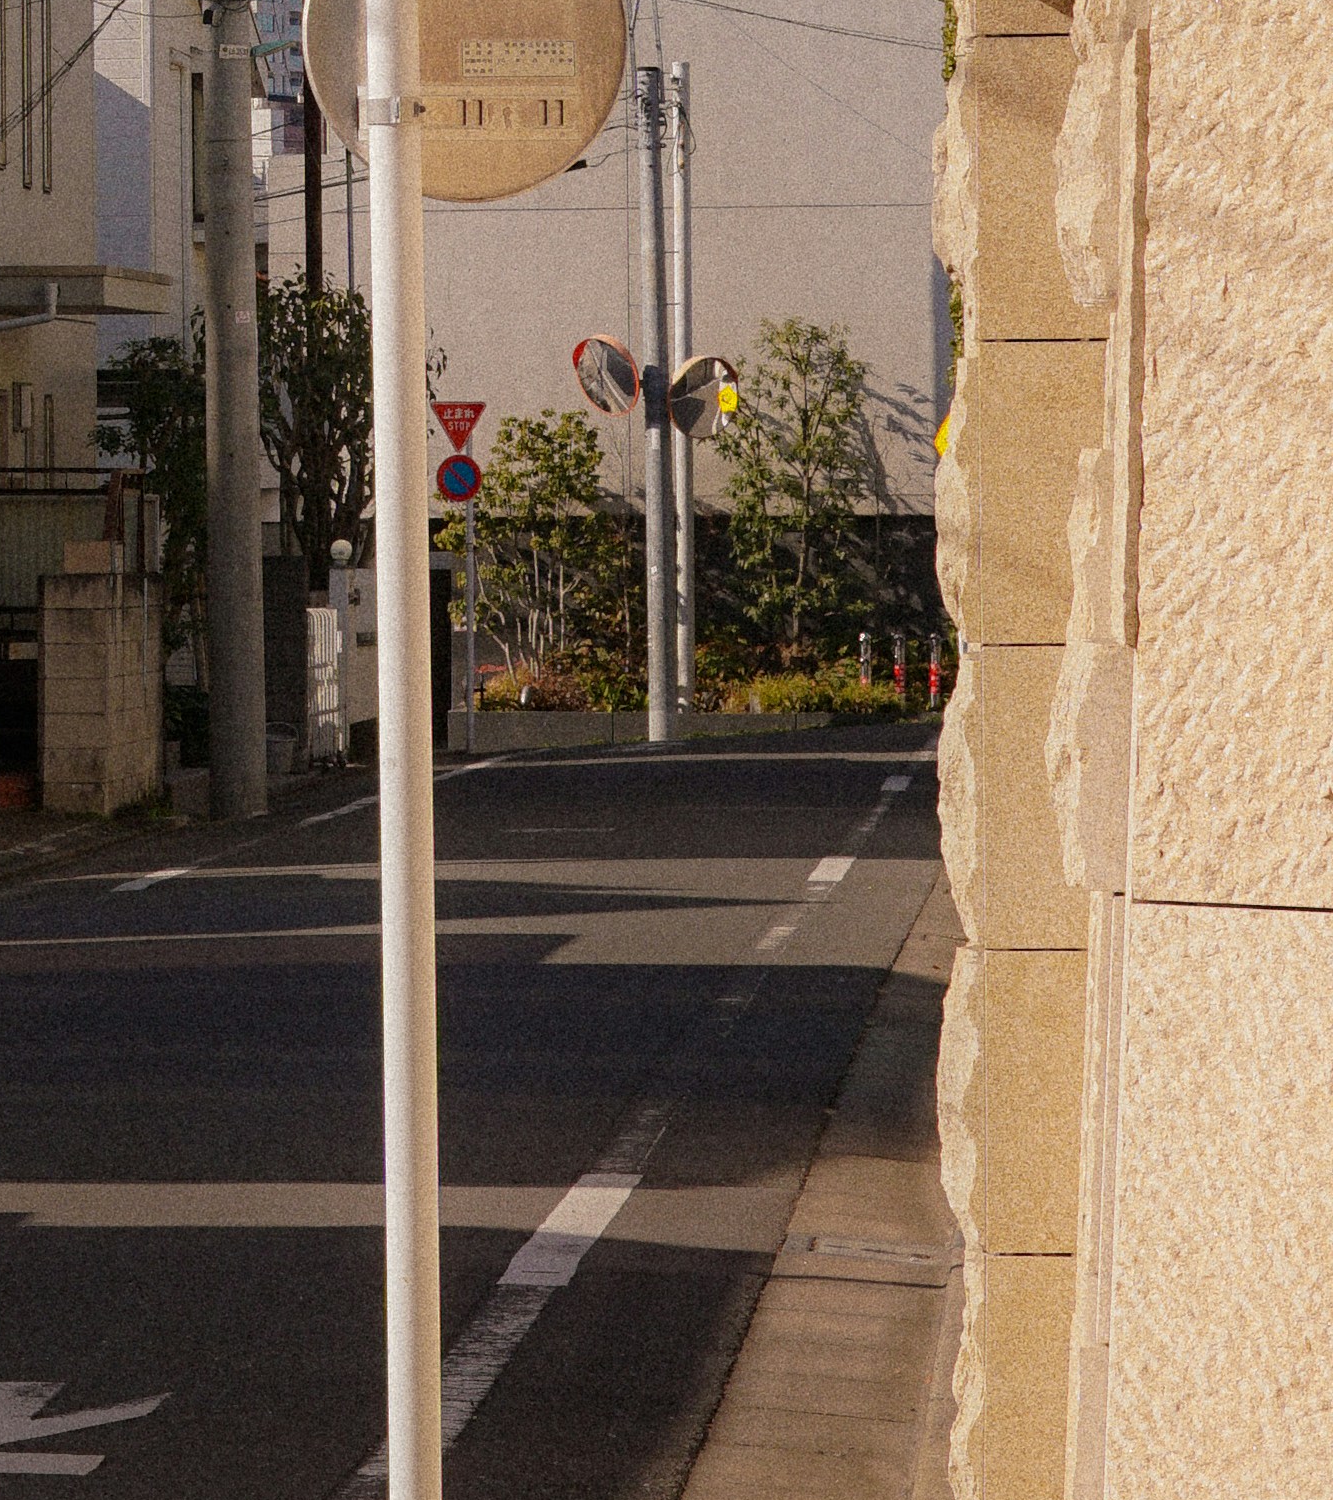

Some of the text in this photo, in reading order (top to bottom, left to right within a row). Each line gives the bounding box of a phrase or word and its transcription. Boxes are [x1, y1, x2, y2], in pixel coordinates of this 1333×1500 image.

[442, 408, 475, 420] 止まれ
[447, 421, 471, 431] STOP
